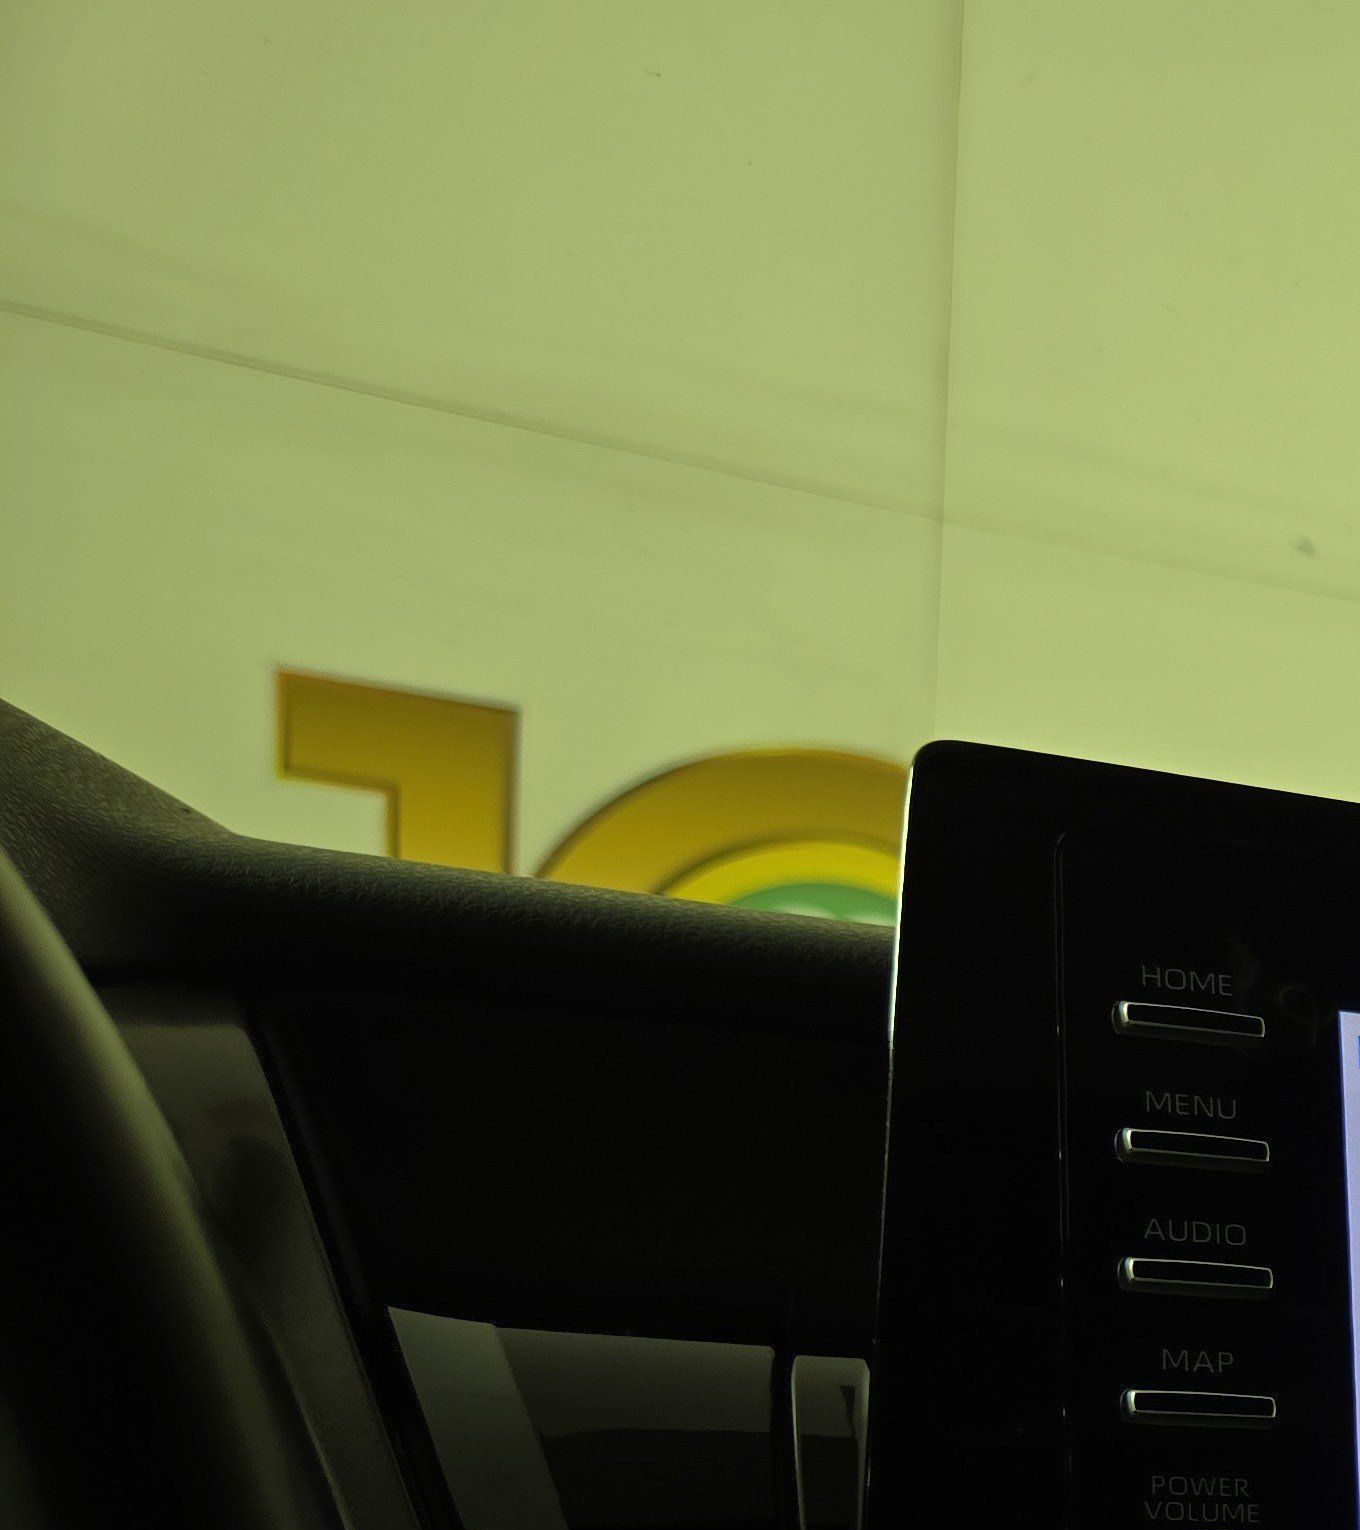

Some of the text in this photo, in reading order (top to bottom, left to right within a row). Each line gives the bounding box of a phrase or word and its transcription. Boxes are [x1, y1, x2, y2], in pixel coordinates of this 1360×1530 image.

[1141, 964, 1233, 997] HOME
[1144, 1090, 1238, 1121] MENU
[1144, 1217, 1248, 1247] AUDIO
[1161, 1348, 1235, 1374] MAP
[1151, 1475, 1249, 1498] POWER
[1143, 1500, 1260, 1524] VOLUME
